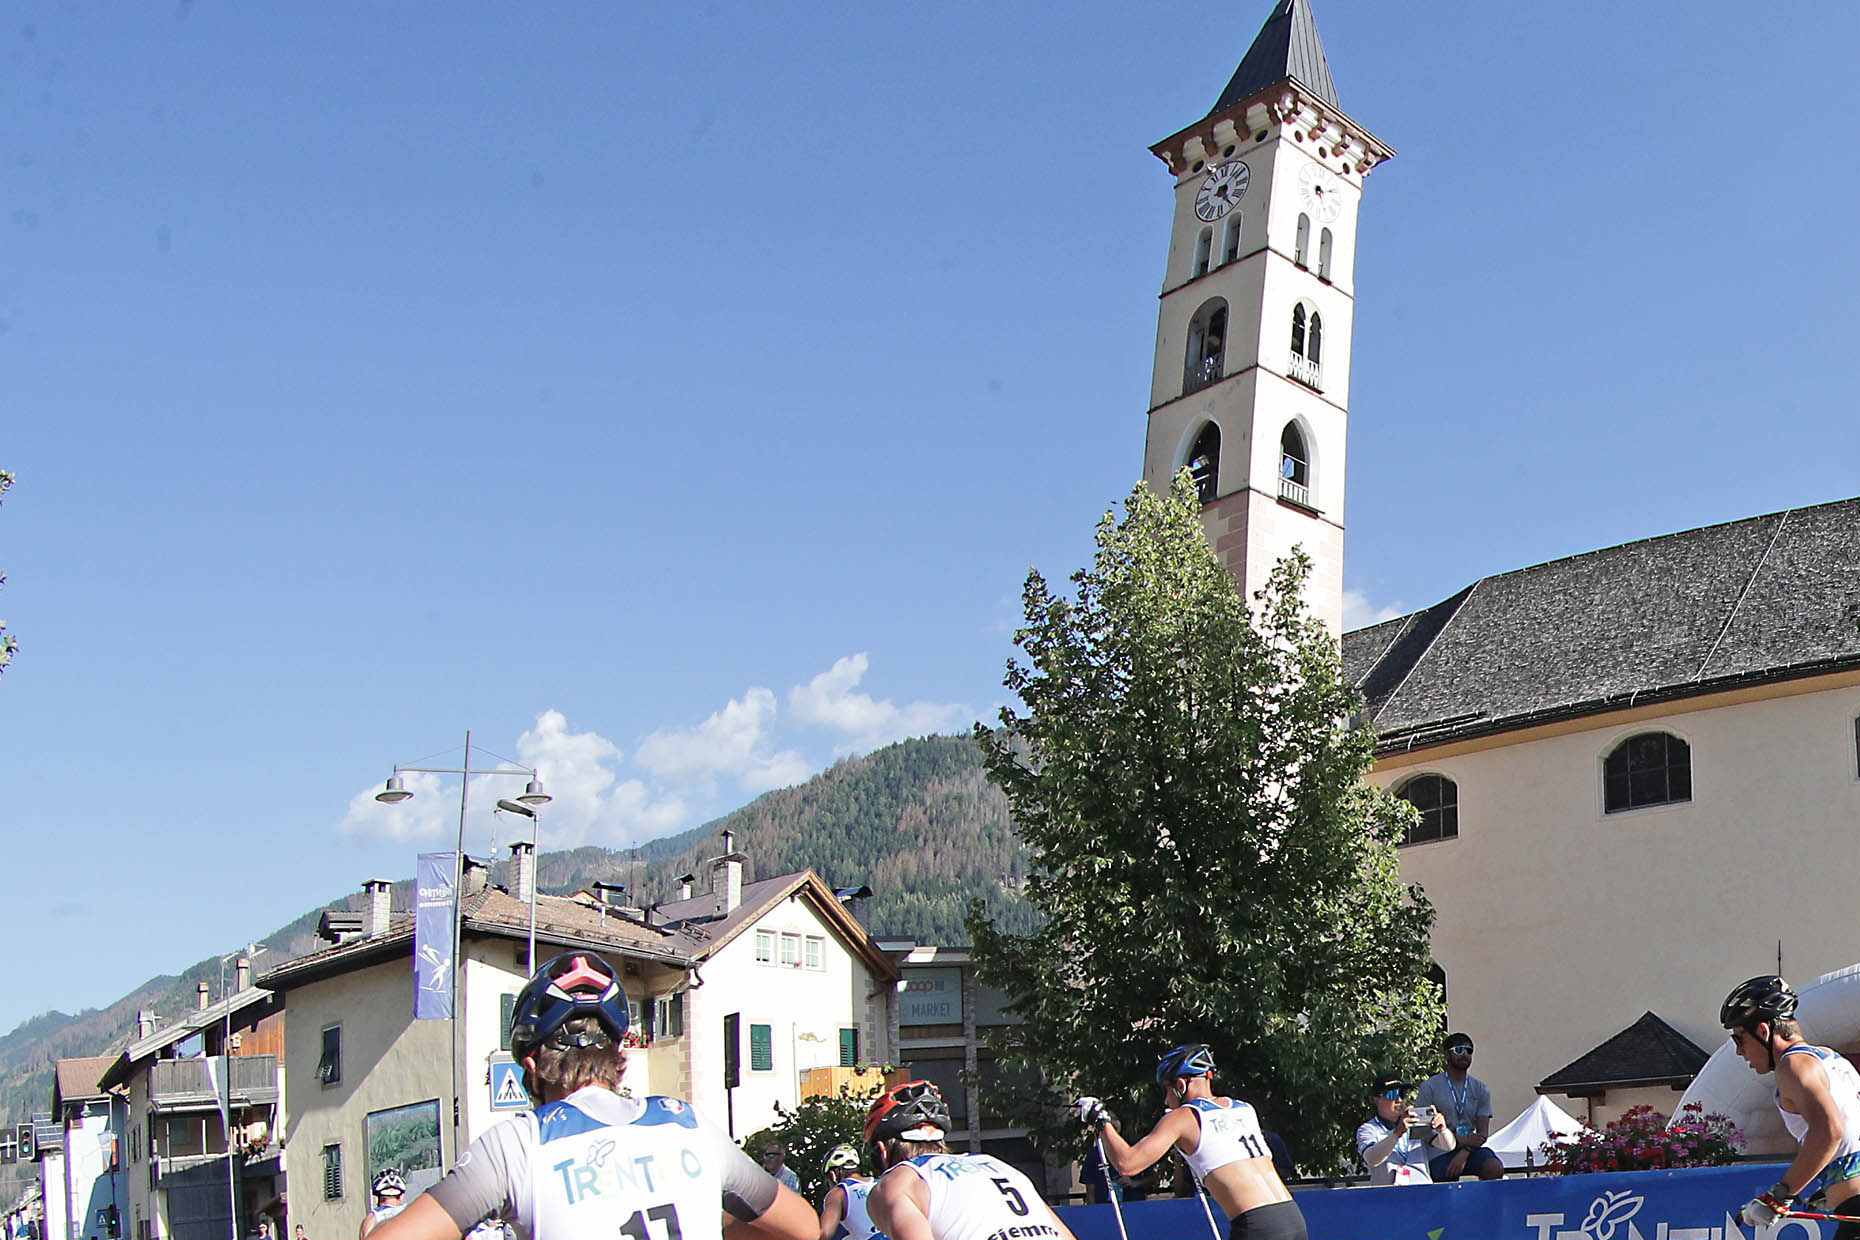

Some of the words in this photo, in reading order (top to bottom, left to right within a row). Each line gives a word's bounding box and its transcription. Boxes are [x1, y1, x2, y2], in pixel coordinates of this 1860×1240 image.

[912, 1002, 951, 1018] MARKET
[1238, 1133, 1264, 1158] 11
[990, 1178, 1030, 1217] 5
